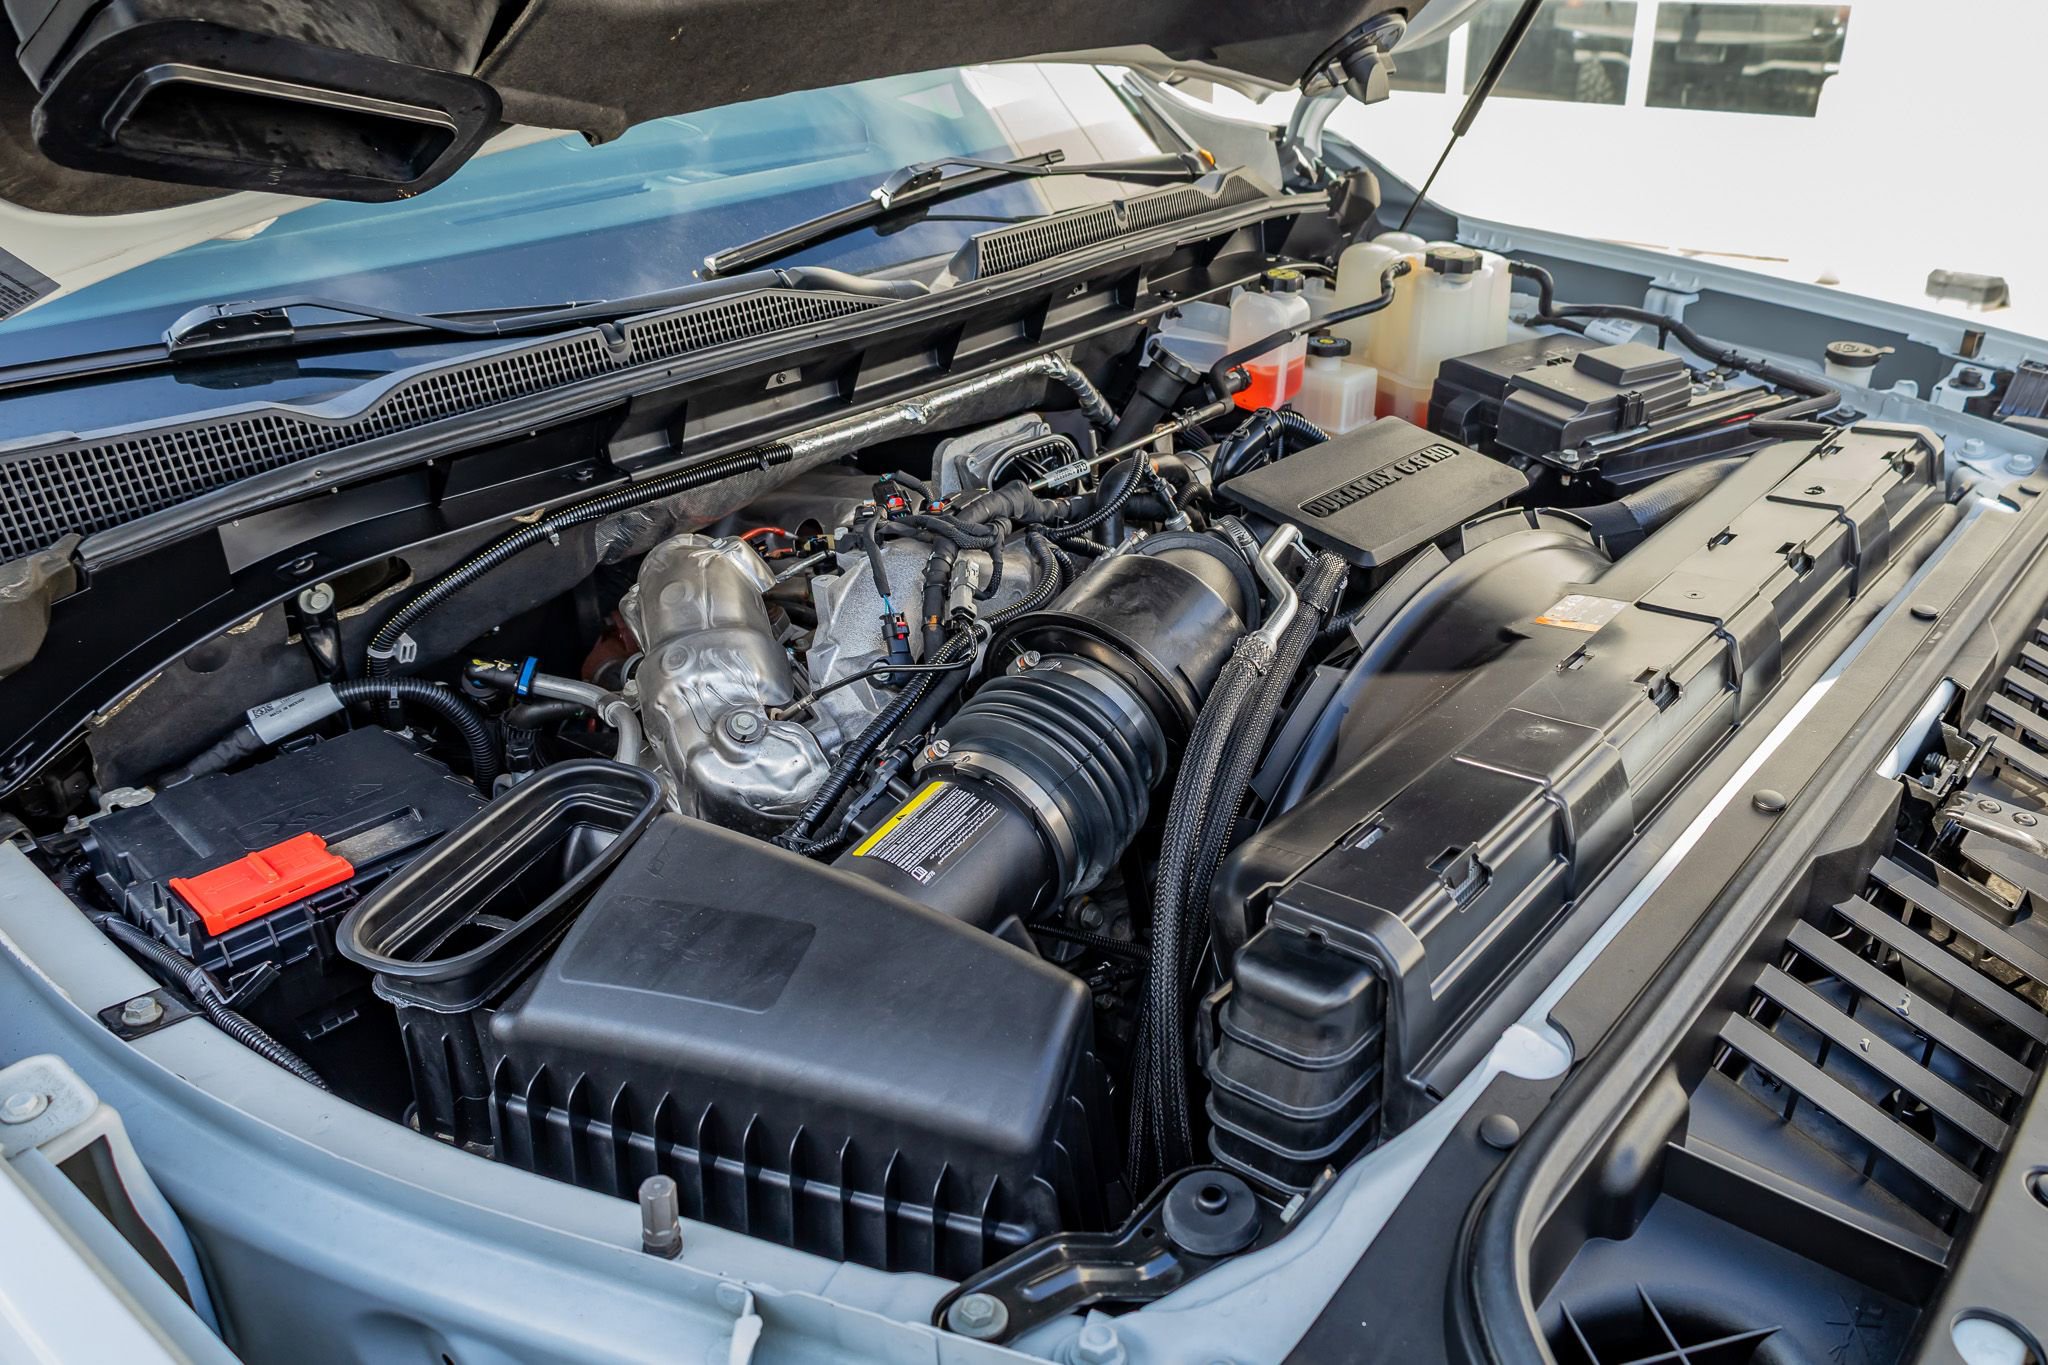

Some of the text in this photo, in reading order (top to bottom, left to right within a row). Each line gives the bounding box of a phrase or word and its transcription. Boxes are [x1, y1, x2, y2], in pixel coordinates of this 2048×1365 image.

[1303, 446, 1455, 517] DURAMAX 6.6 HD
